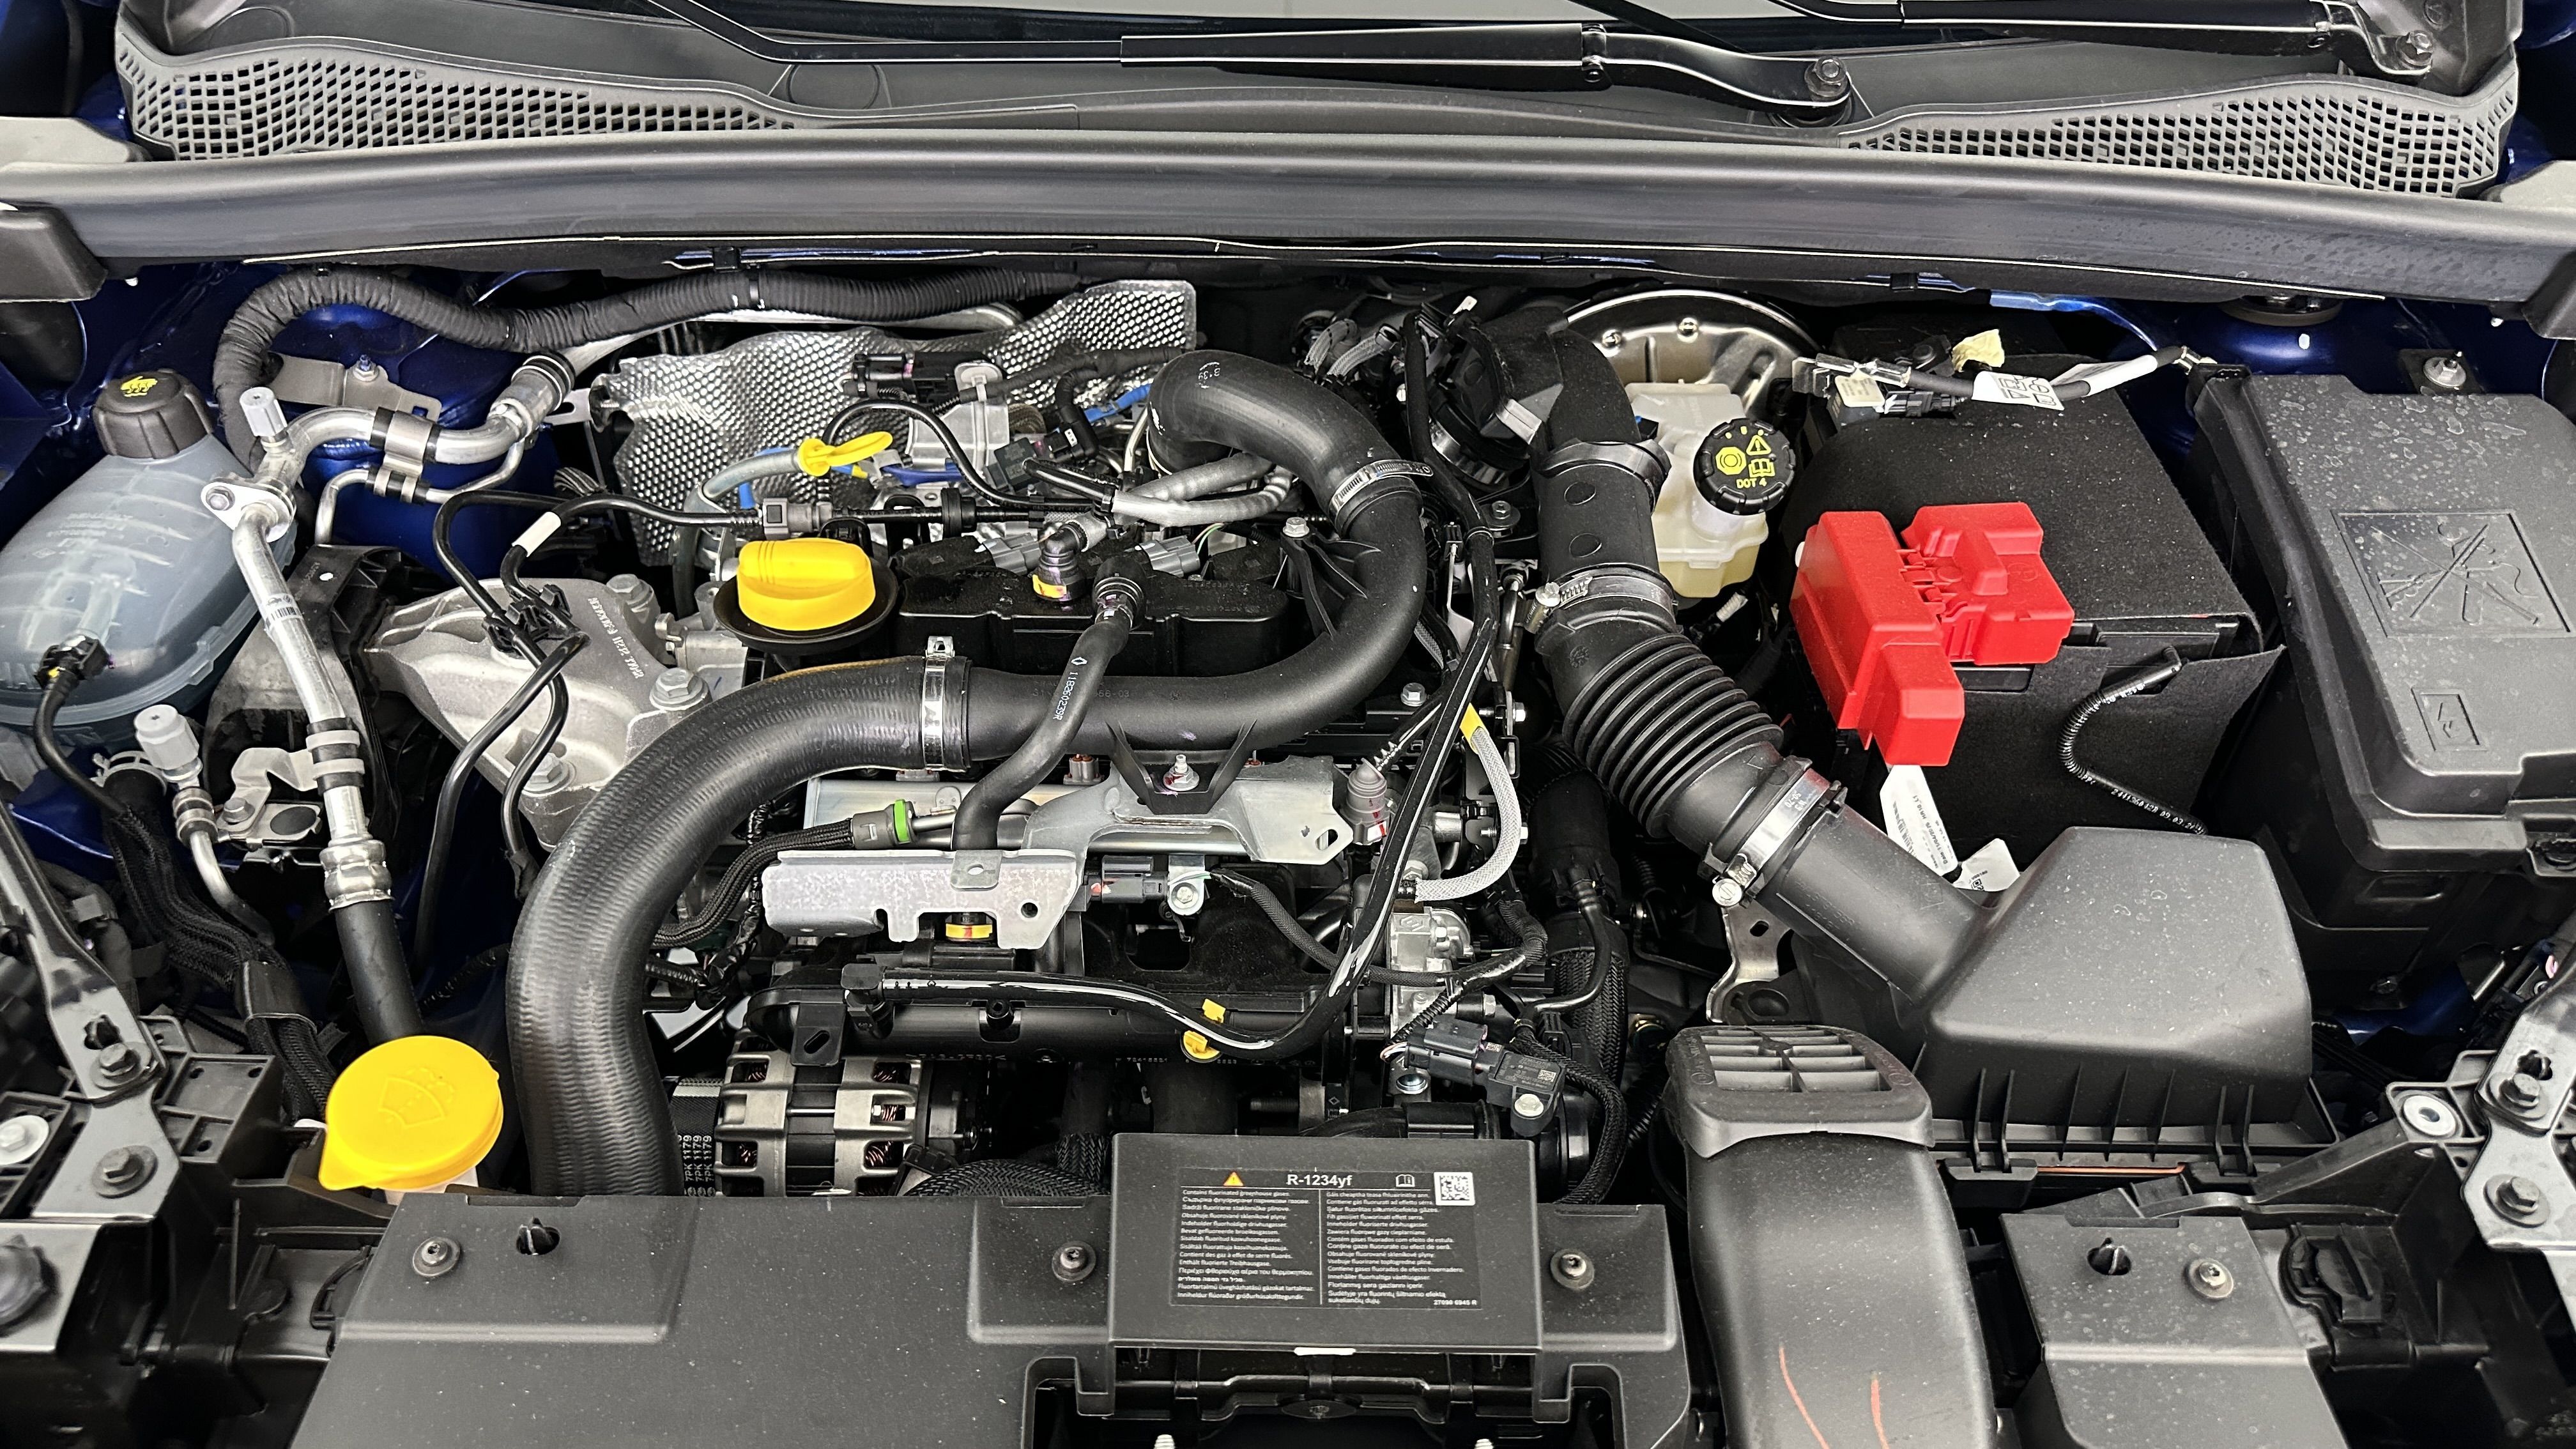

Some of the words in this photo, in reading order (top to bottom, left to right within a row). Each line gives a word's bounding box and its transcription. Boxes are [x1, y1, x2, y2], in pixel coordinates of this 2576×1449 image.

[1736, 478, 1758, 489] DOT
[1759, 477, 1767, 487] 4
[1052, 671, 1078, 721] 118260239R
[682, 1135, 693, 1160] 1179
[693, 1135, 702, 1160] 1179
[703, 1135, 712, 1160] 1179
[1287, 1174, 1353, 1188] R-1234yf
